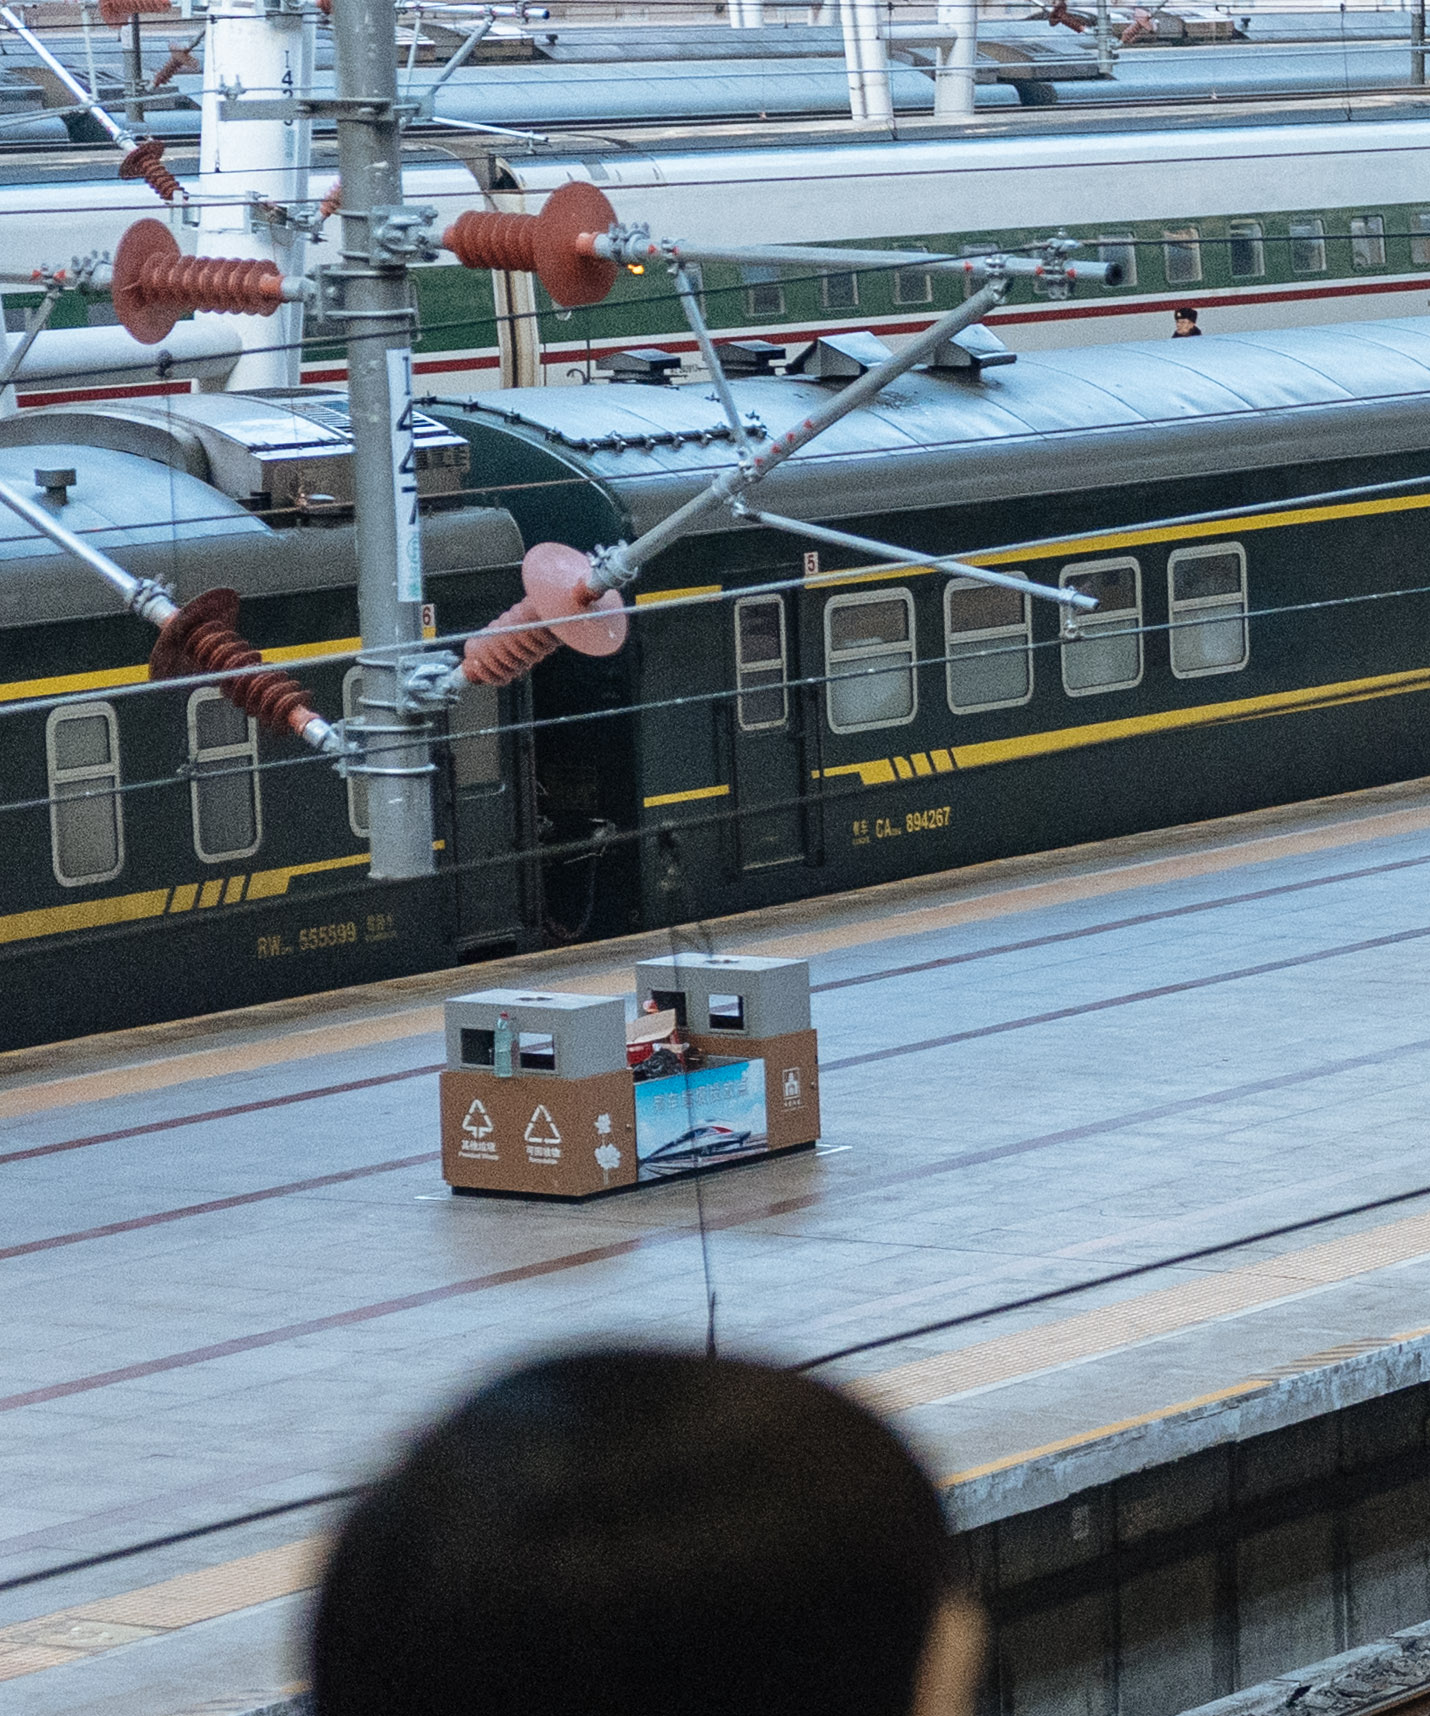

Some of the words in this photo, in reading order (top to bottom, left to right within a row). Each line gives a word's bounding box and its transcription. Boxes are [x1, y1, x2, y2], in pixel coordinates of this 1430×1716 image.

[806, 553, 816, 573] 5
[423, 606, 431, 626] 6
[905, 806, 952, 832] 894267
